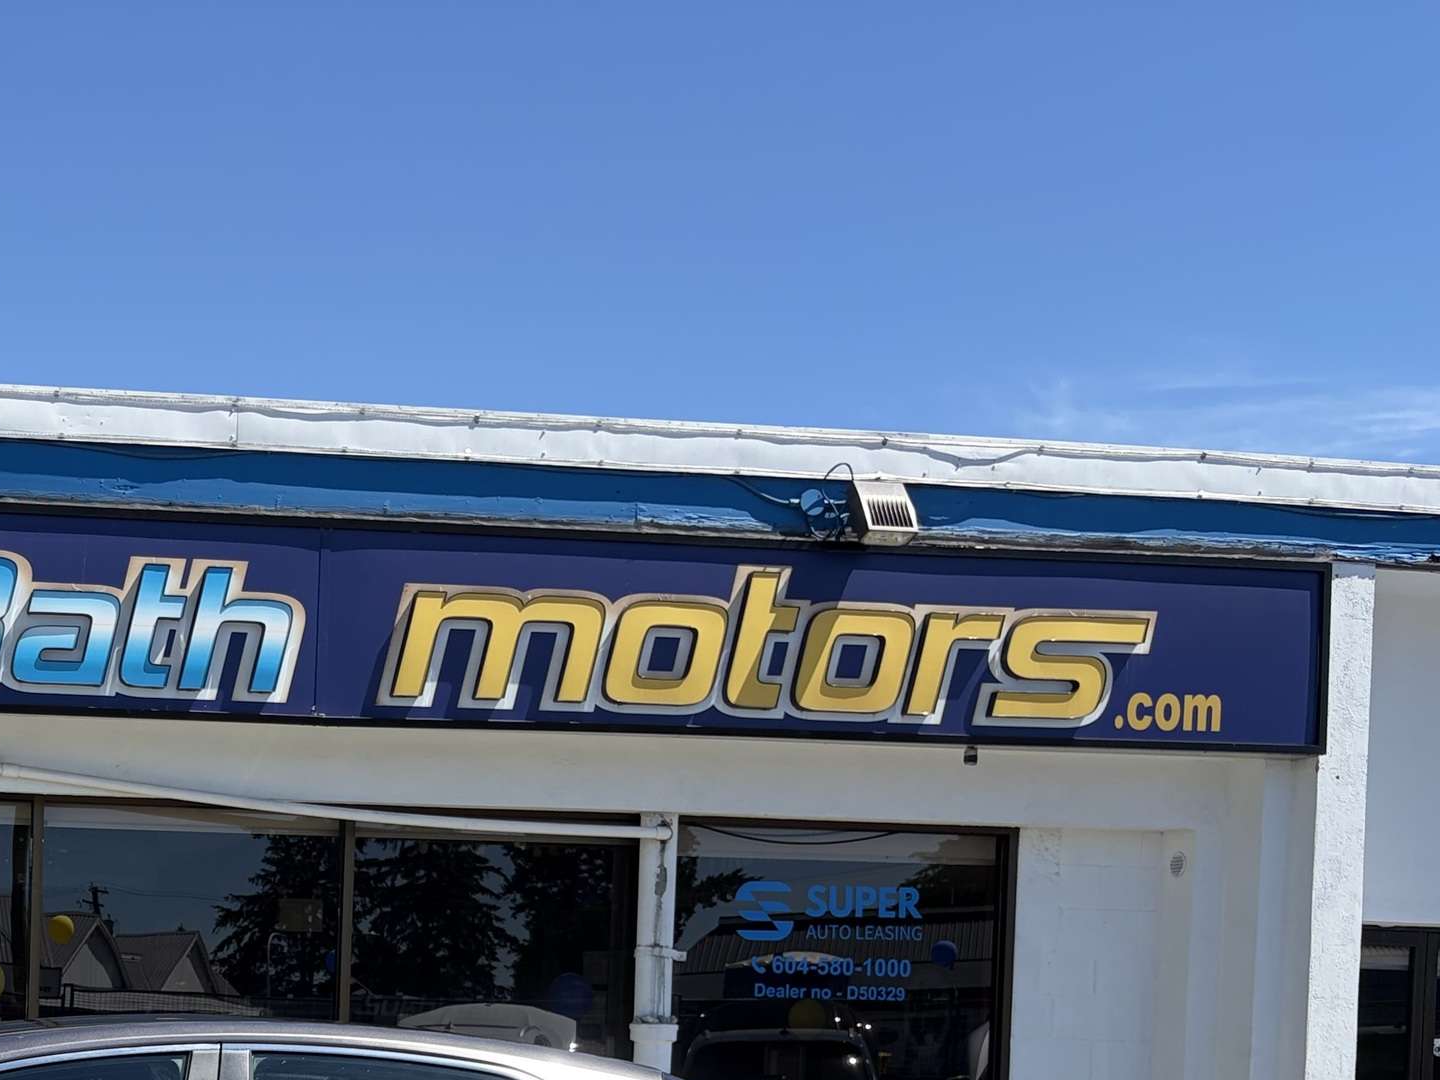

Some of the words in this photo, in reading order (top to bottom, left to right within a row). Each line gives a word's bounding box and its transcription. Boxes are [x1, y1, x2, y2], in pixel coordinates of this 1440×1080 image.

[375, 565, 1158, 728] motors
[805, 885, 924, 919] SUPER
[806, 925, 852, 940] AUTO
[855, 925, 923, 941] LEASING
[772, 956, 911, 978] 604-580-1000
[754, 983, 807, 999] Dealer
[811, 988, 832, 999] no
[847, 986, 906, 1001] D50329
